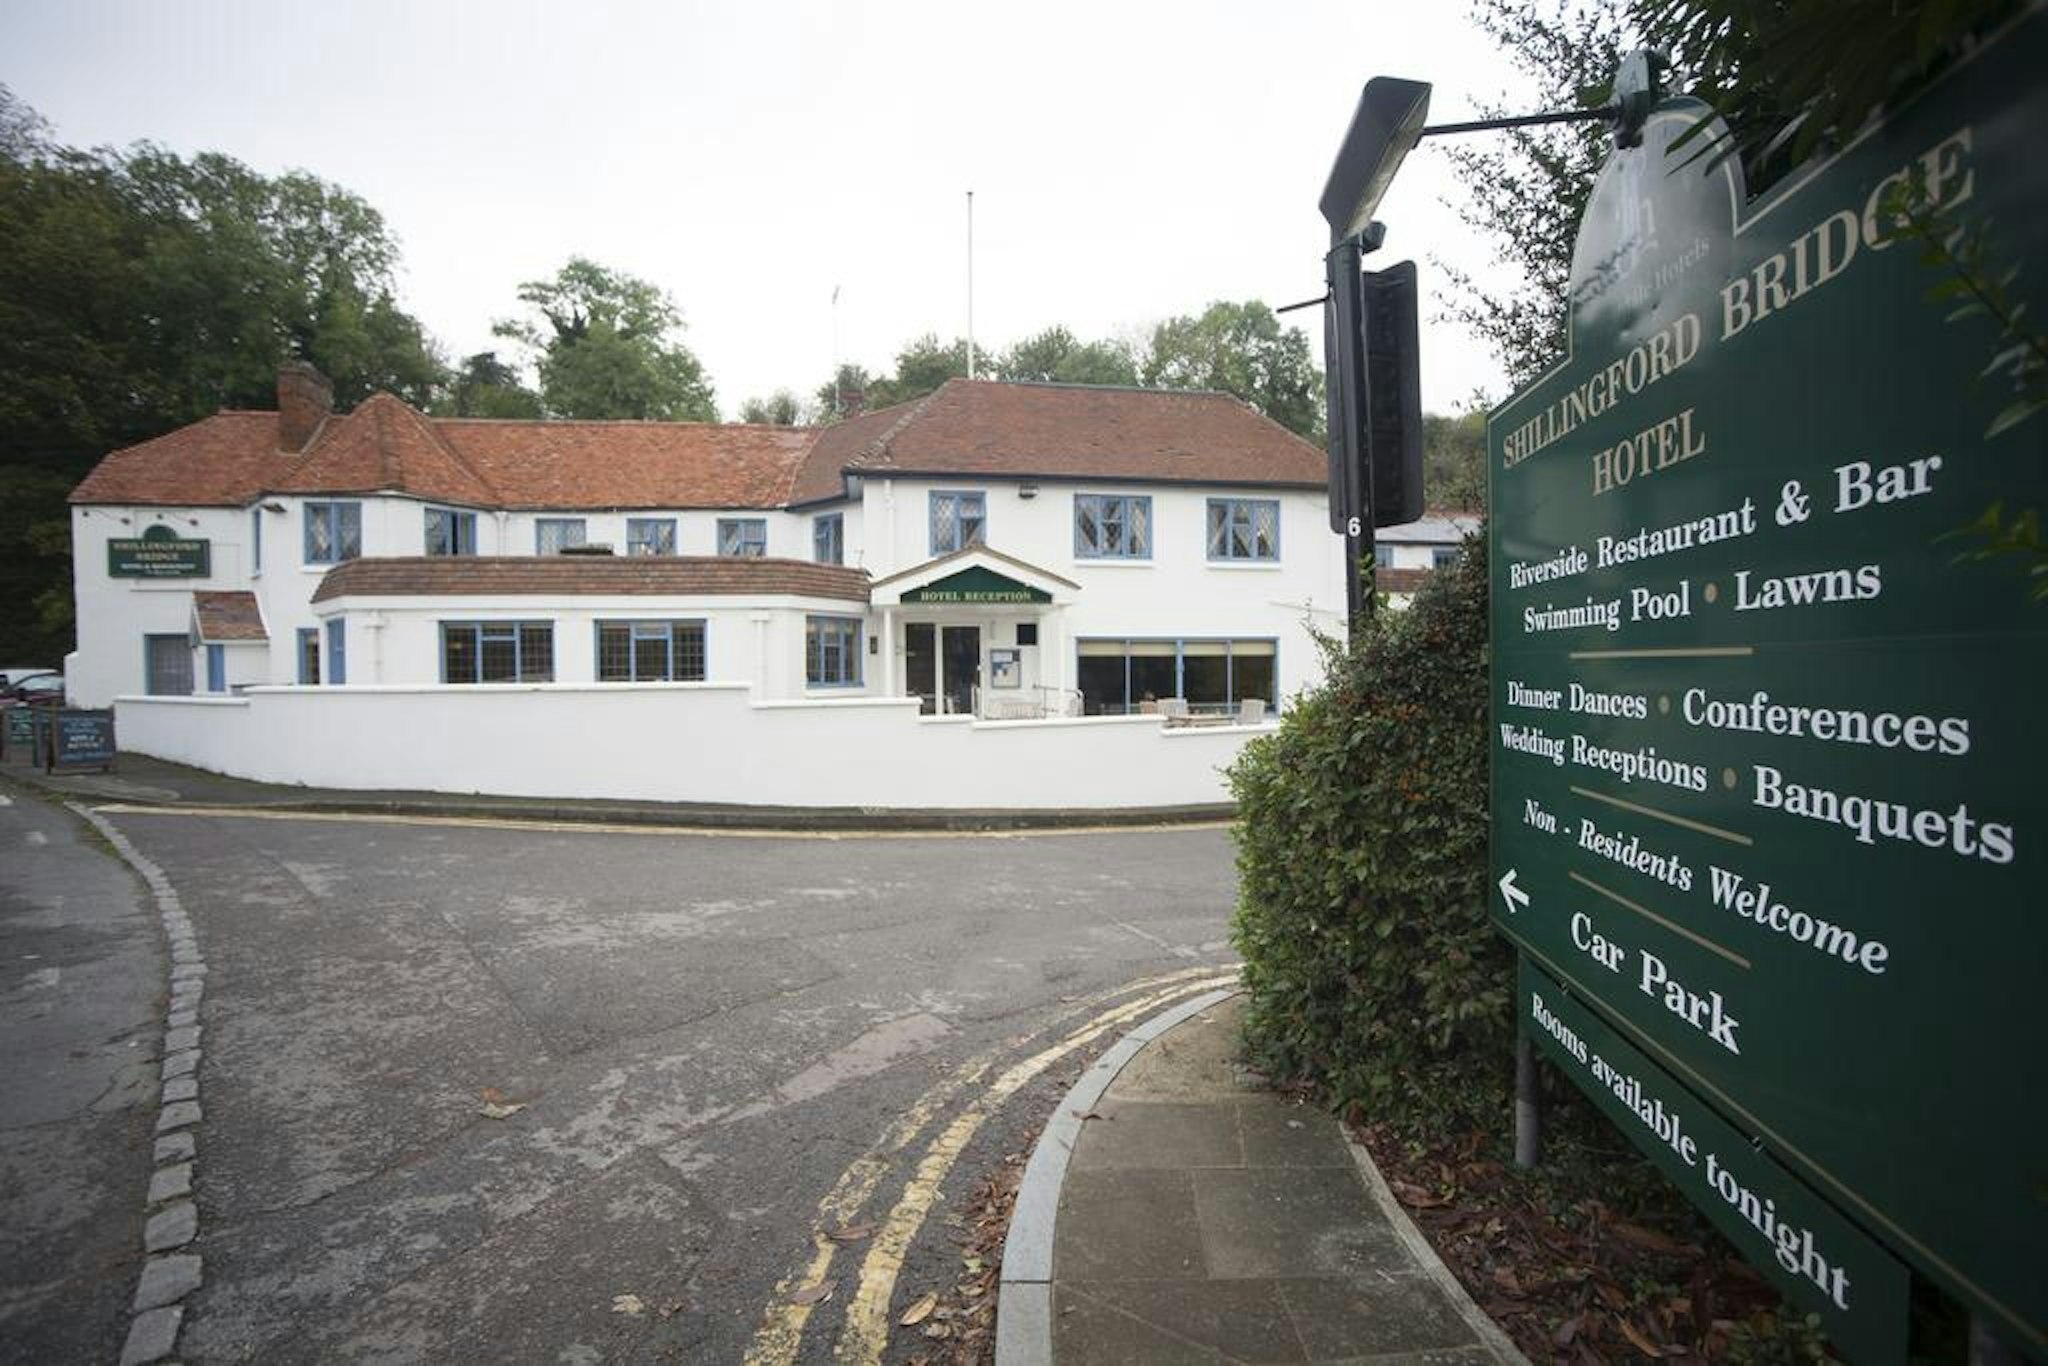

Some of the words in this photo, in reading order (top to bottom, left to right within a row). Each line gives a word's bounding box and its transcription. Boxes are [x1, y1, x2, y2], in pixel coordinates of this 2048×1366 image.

[1503, 313, 1702, 470] SHILLINGFORD
[1719, 125, 1974, 343] BRIDGE
[1592, 408, 1706, 497] HOTEL
[1348, 517, 1361, 537] 6
[1509, 544, 1589, 590] Riverside
[1596, 496, 1757, 568] Restaurant
[1775, 479, 1811, 527] &
[1832, 453, 1944, 514] Bar
[920, 591, 960, 602] HOTEL
[964, 590, 1032, 603] RECEPTION
[1523, 597, 1622, 634] Swimming
[1631, 580, 1691, 622] Pool
[1734, 563, 1883, 612] Lawns
[1507, 680, 1562, 711] Dinner
[1569, 683, 1648, 720] Dances
[1682, 687, 1970, 756] Conferences
[1499, 722, 1565, 765] Wedding
[1571, 734, 1708, 793] Receptions
[1753, 764, 2016, 865] Banquets
[1523, 798, 1557, 834] Non
[1578, 817, 1694, 892] Residents
[1709, 865, 1890, 975] Welcome
[1569, 910, 1626, 974] Car
[1639, 949, 1742, 1056] Park
[1532, 991, 1588, 1067] Rooms
[1591, 1051, 1697, 1167] available
[1706, 1152, 1851, 1310] tonight
